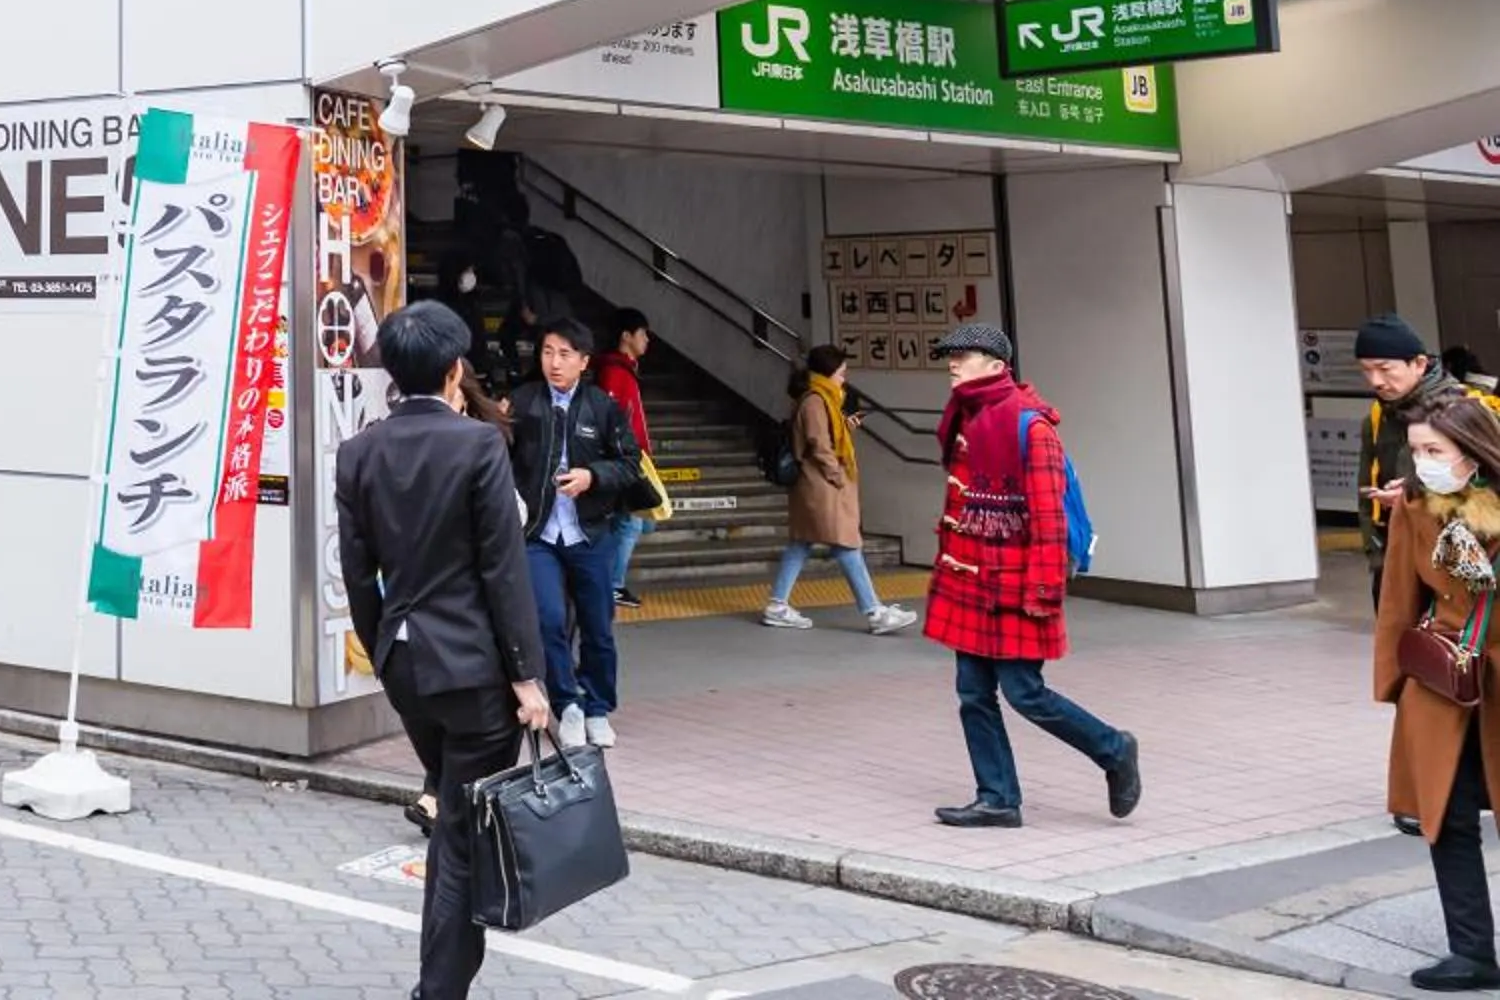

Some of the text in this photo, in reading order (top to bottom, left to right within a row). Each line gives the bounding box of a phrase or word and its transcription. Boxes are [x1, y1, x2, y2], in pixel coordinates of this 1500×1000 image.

[740, 4, 812, 63] JR
[829, 12, 957, 69] 浅草橋駅
[1051, 5, 1106, 43] JR
[752, 61, 804, 81] JR東日本
[832, 67, 994, 106] Asakusabashi Station
[1131, 74, 1149, 97] JB
[1047, 77, 1103, 100] Entrance
[318, 93, 371, 130] CAFE
[102, 115, 141, 146] BA
[318, 131, 386, 171] DINING
[318, 173, 362, 207] BAR
[827, 242, 986, 270] エレベーター
[12, 282, 28, 293] TEL
[840, 289, 944, 315] は西口に
[116, 193, 235, 531] パスタランチ
[223, 202, 284, 502] シェフこだわりの本格派
[841, 335, 945, 361] ございま
